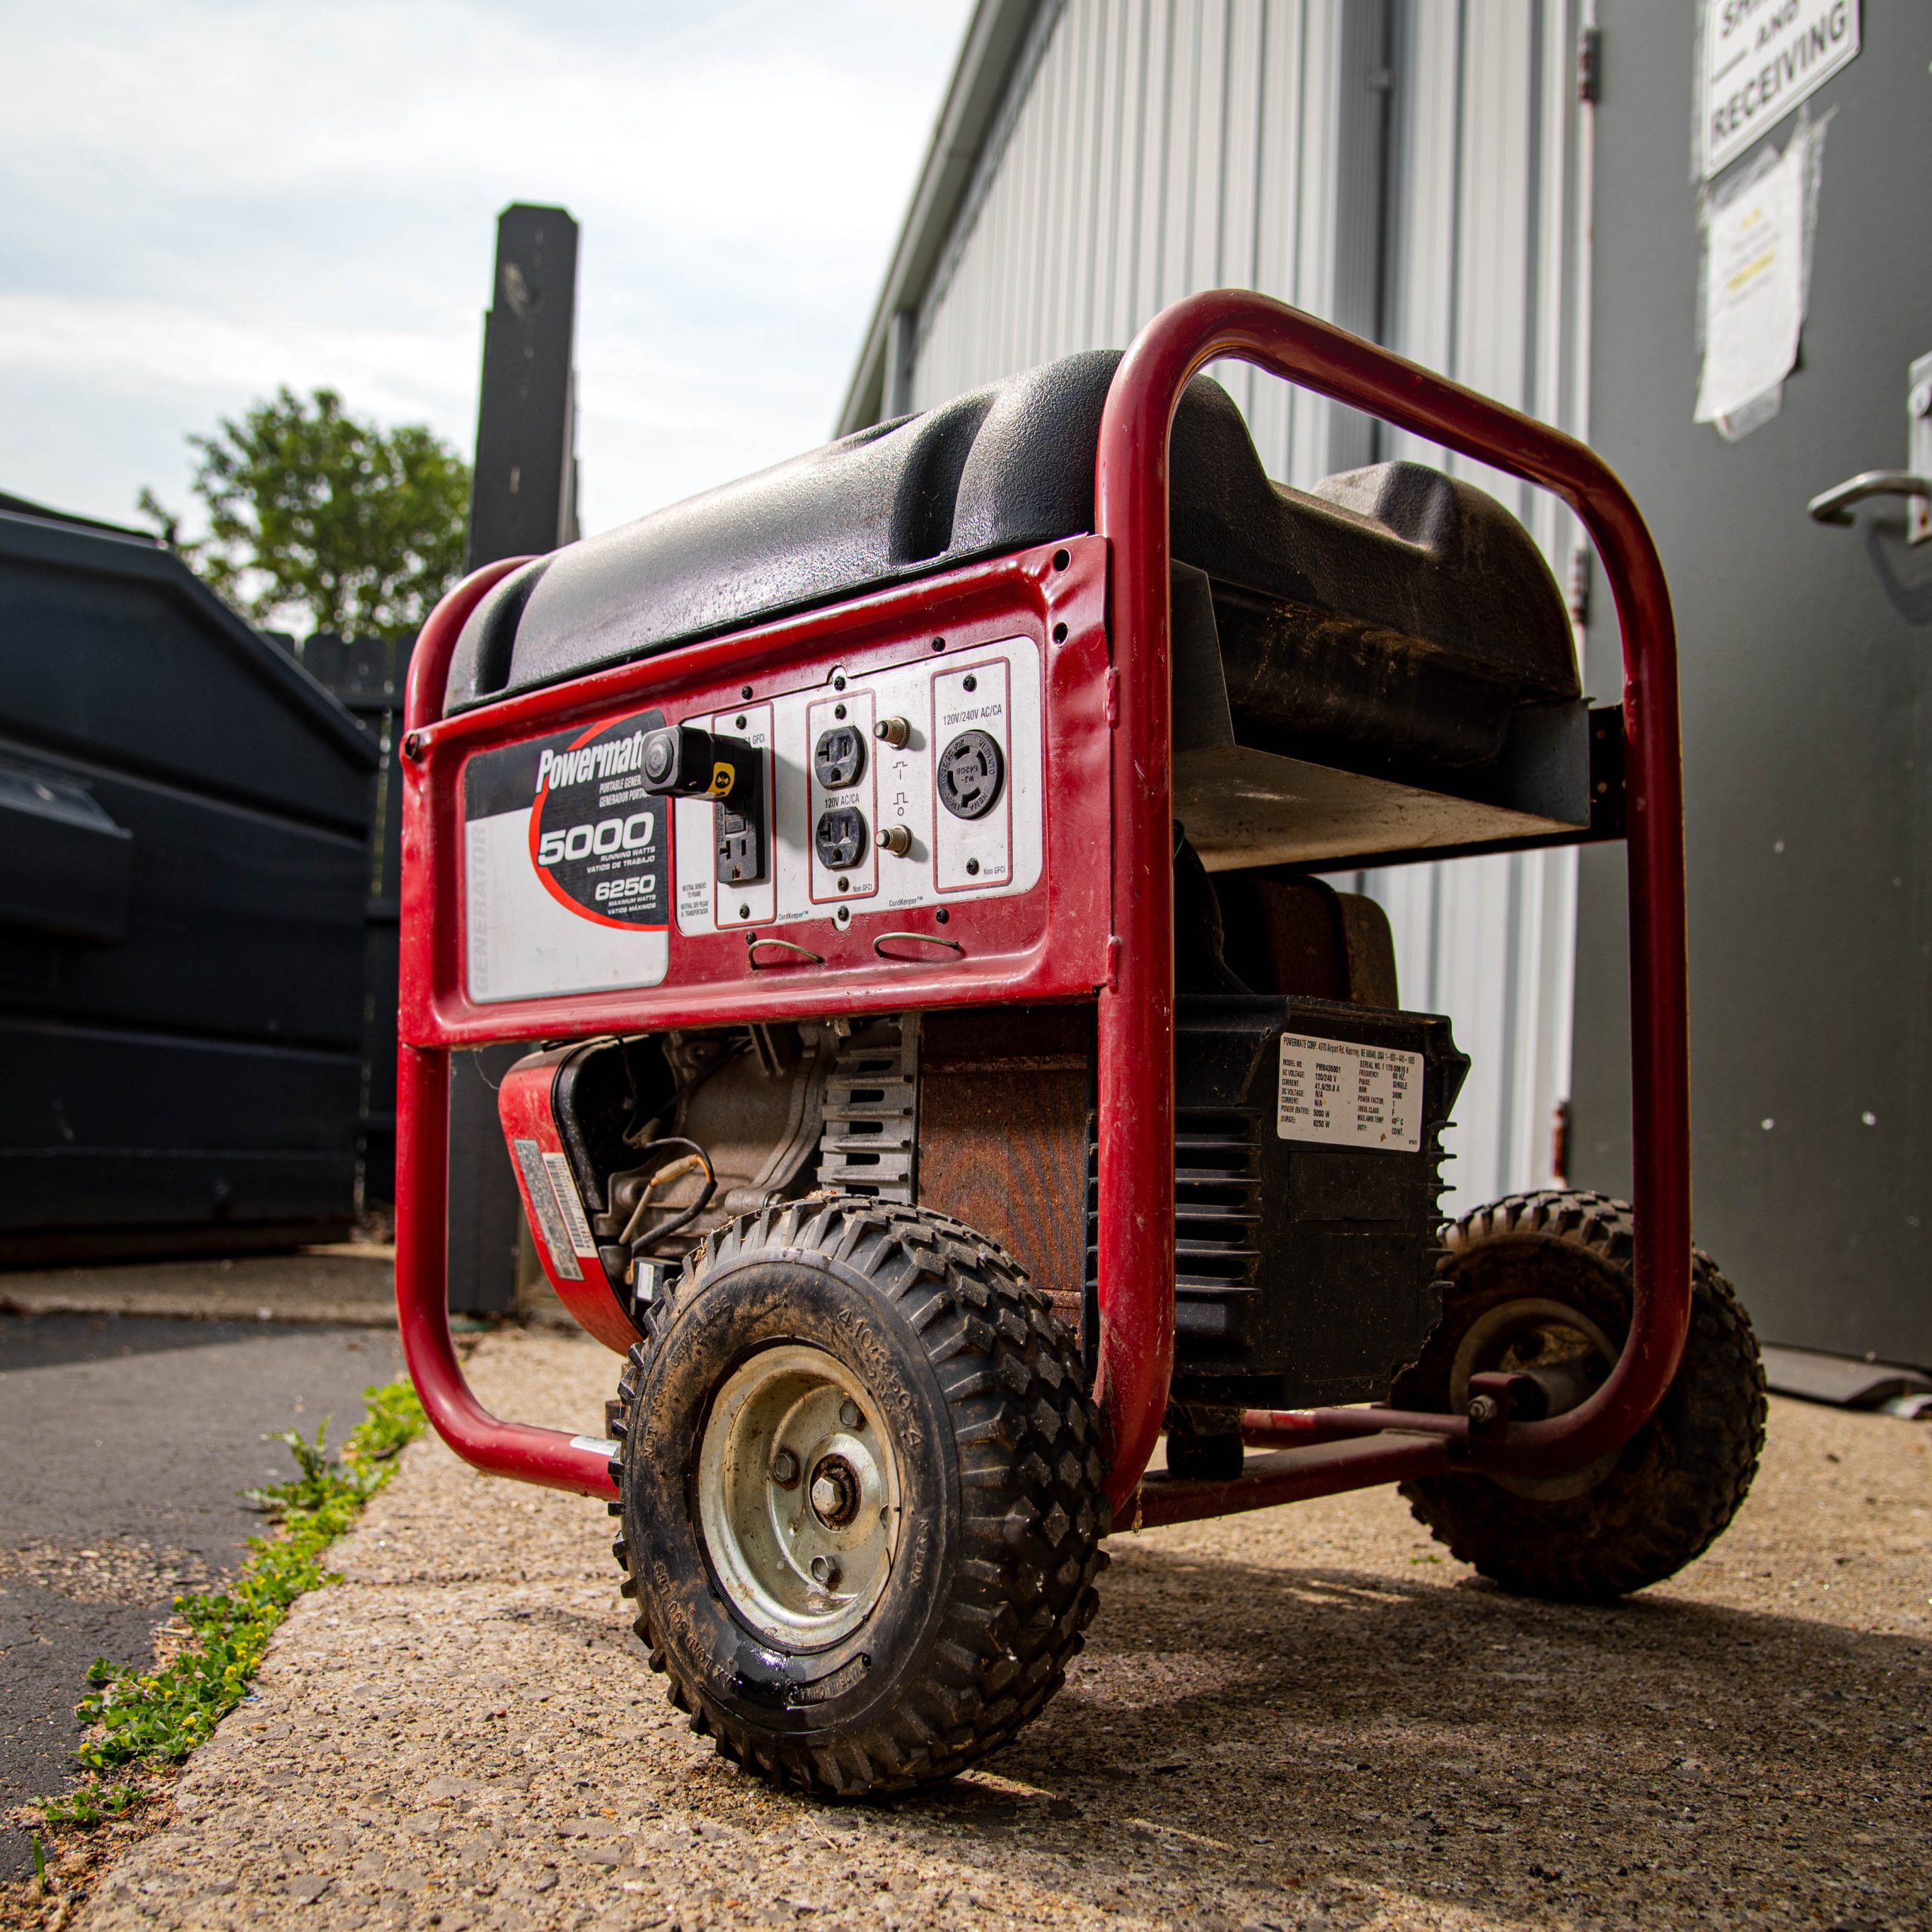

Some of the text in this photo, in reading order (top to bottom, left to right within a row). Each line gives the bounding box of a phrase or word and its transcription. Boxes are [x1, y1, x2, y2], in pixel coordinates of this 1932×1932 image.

[1754, 0, 1799, 52] AND
[1712, 1, 1847, 143] RECEIVING
[943, 703, 1002, 726] 120V/240V AC/CA
[752, 733, 764, 744] GFCI
[536, 730, 642, 793] Powermat
[599, 775, 641, 794] PORTABLE GENER
[599, 788, 650, 808] GENERADOR PORTA
[825, 793, 860, 808] 120V AC/CA
[537, 811, 654, 866] 5000
[601, 846, 655, 862] RUNNING WATTS
[587, 856, 655, 873] VATIOS DE TRABAJO
[995, 866, 1005, 874] GFCI
[595, 874, 656, 901] 6250
[608, 894, 656, 907] MAXIMUM WATTS
[472, 826, 488, 993] GENERATOR
[608, 906, 627, 915] VATIOS
[1283, 1036, 1306, 1048] POWERMATE
[1359, 1060, 1374, 1069] SERIAL
[1282, 1078, 1300, 1087] CURRENT:
[1315, 1073, 1331, 1081] 120/240
[1392, 1081, 1407, 1089] SINGLE
[1281, 1096, 1300, 1104] CURRENT:
[1313, 1109, 1324, 1117] 5000
[1391, 1128, 1404, 1136] CONT.
[642, 1426, 657, 1460] NOT
[650, 1386, 667, 1419] FOR
[910, 1518, 929, 1586] NYLON
[684, 1631, 712, 1671] LOAD
